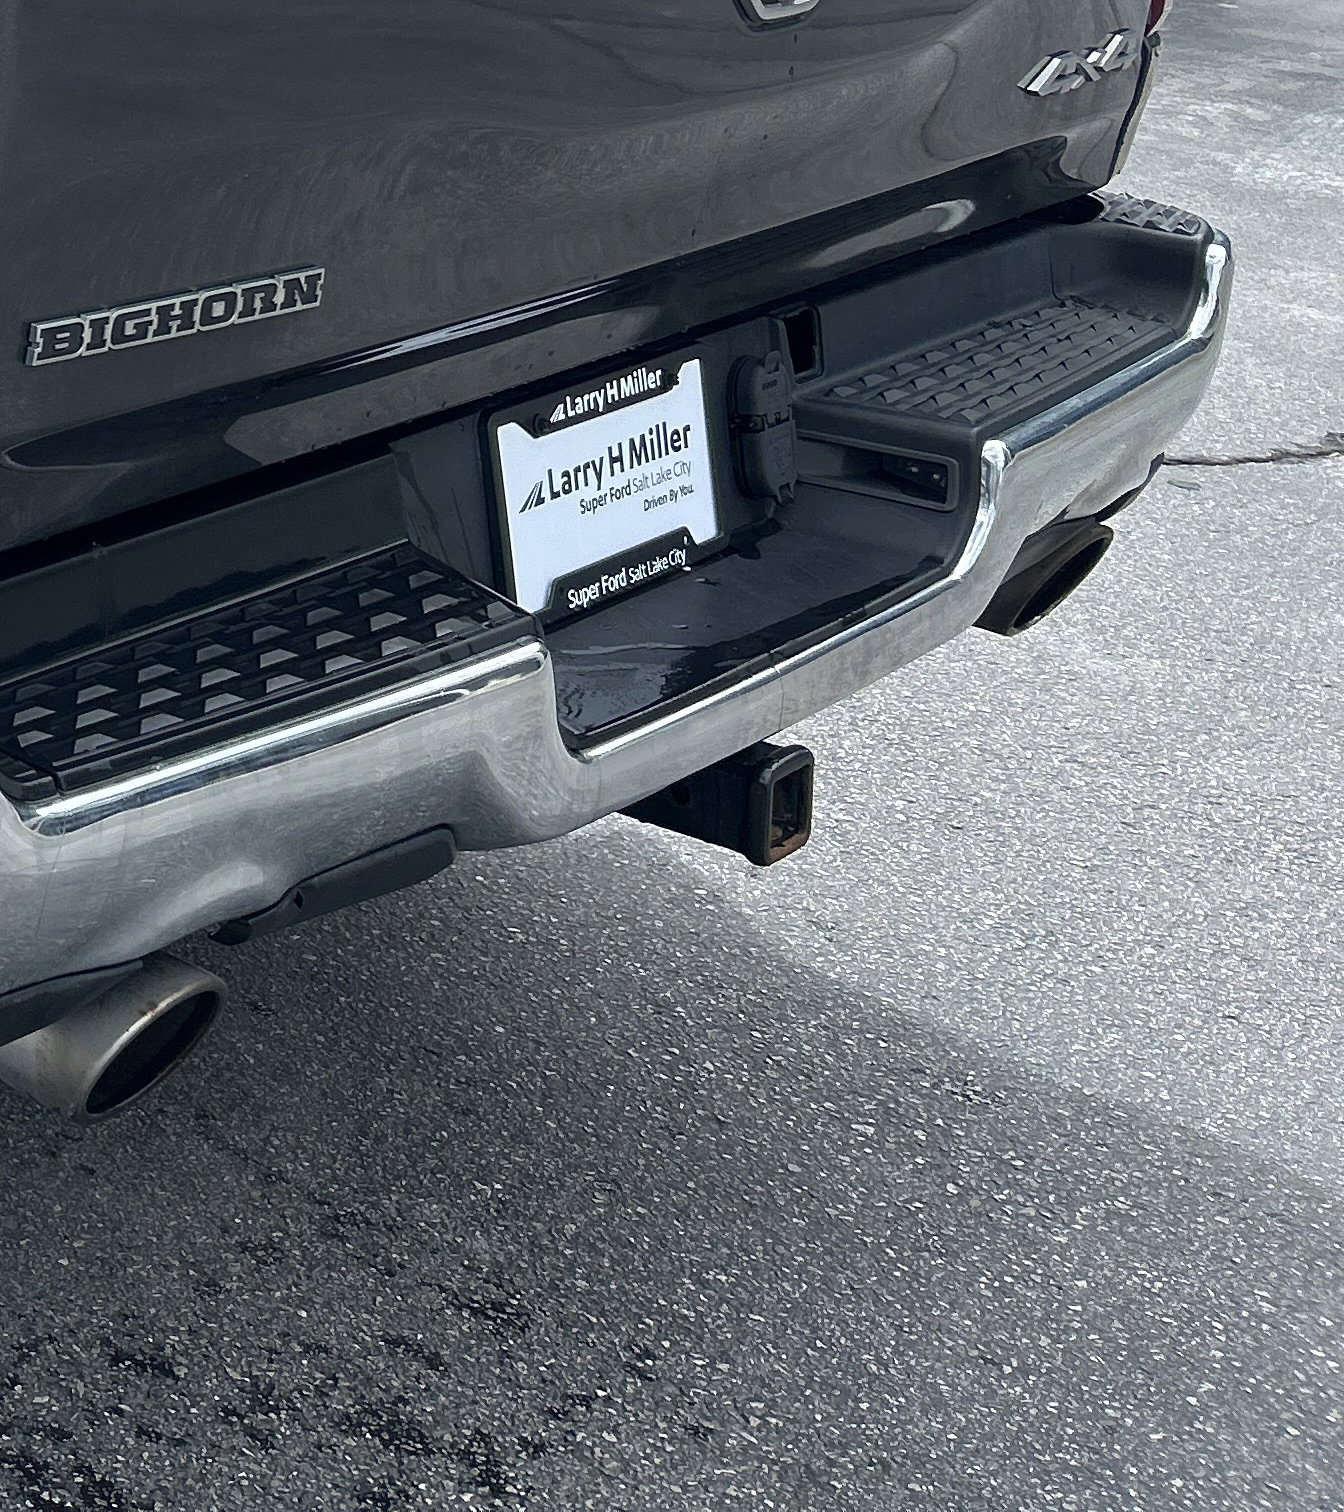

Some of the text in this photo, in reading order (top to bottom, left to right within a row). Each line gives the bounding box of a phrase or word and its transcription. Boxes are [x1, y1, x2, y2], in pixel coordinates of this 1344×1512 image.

[26, 267, 325, 366] BIGHORN
[566, 367, 662, 417] Larry H Miller
[548, 422, 691, 501] Larry H Miller
[580, 459, 692, 515] Super Ford Salt Lake City
[568, 547, 687, 609] Super Ford Salt Lake City
